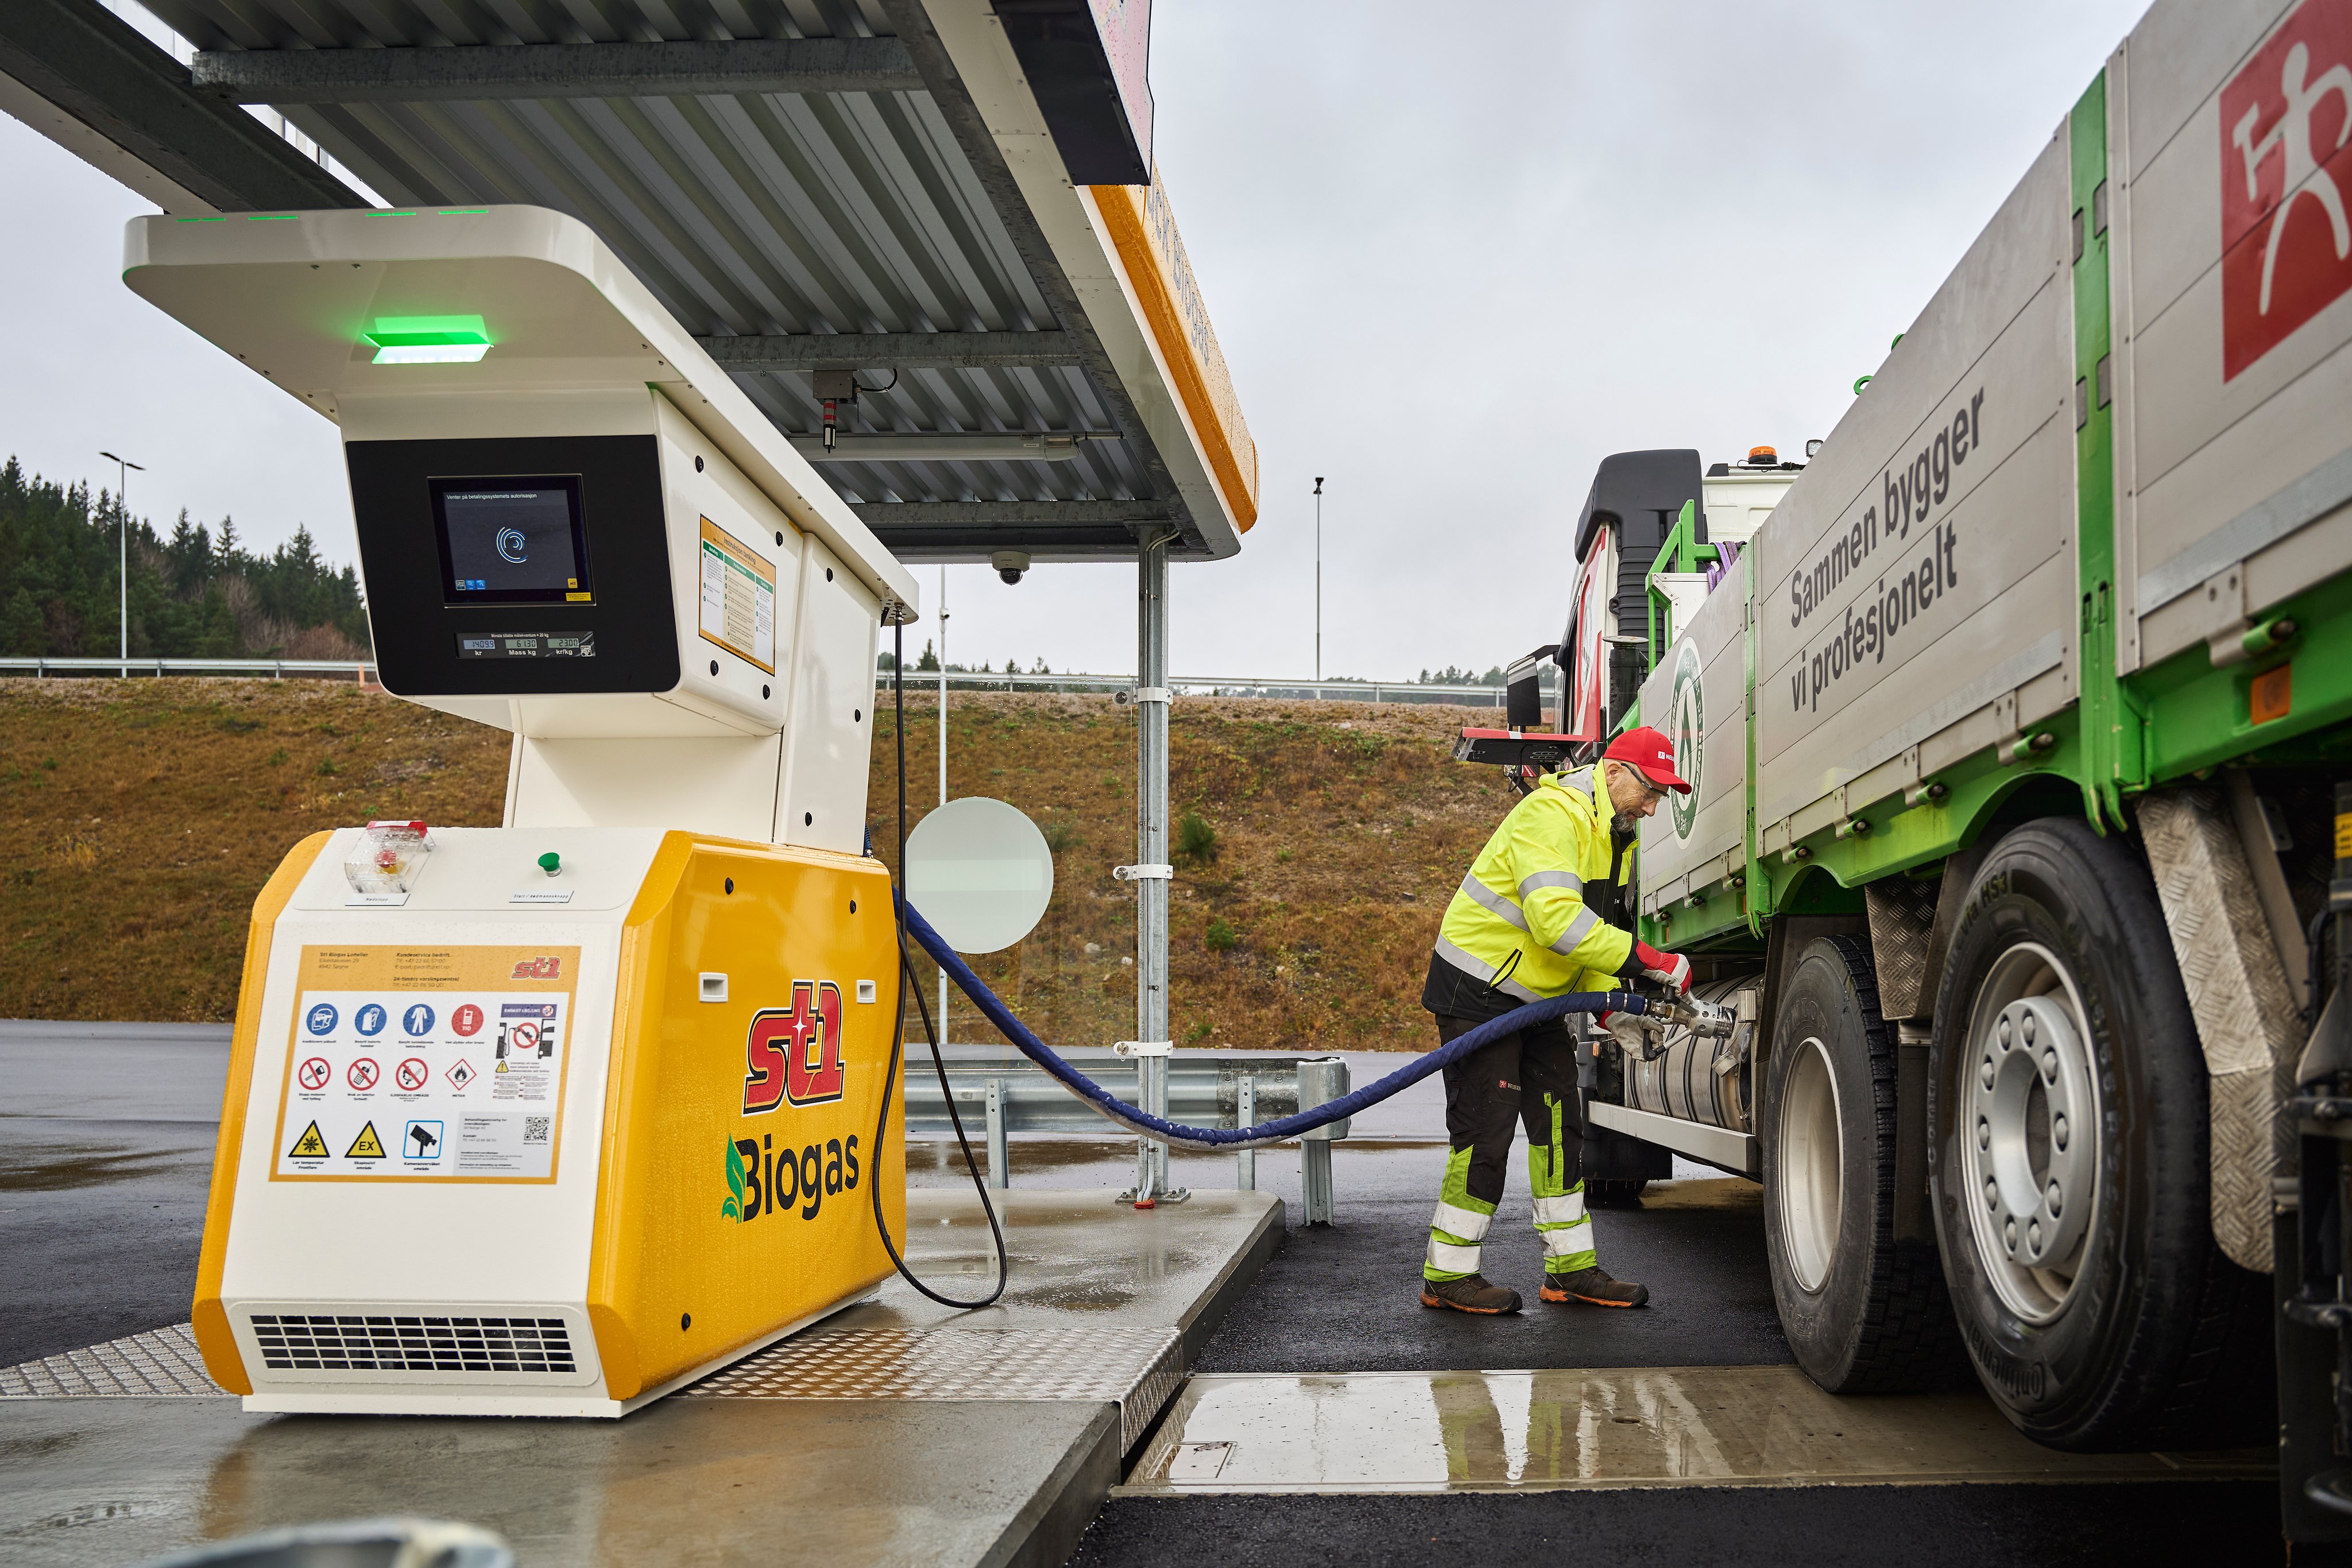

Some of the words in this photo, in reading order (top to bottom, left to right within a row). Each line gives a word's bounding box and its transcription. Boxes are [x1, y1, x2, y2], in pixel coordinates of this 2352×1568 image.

[1139, 174, 1169, 265] uck
[1791, 505, 1877, 628] Sammen
[1885, 385, 1984, 540] bygger
[724, 537, 743, 556] Instruksjon
[743, 550, 756, 565] tanking
[1791, 650, 1806, 711] vi
[1812, 518, 1957, 713] profesjonelt
[1980, 870, 2007, 908] HS3
[511, 957, 562, 979] st1
[741, 978, 846, 1117] st1
[358, 1141, 375, 1151] EX
[732, 1133, 860, 1222] Biogas
[1968, 1319, 2045, 1402] Continental
